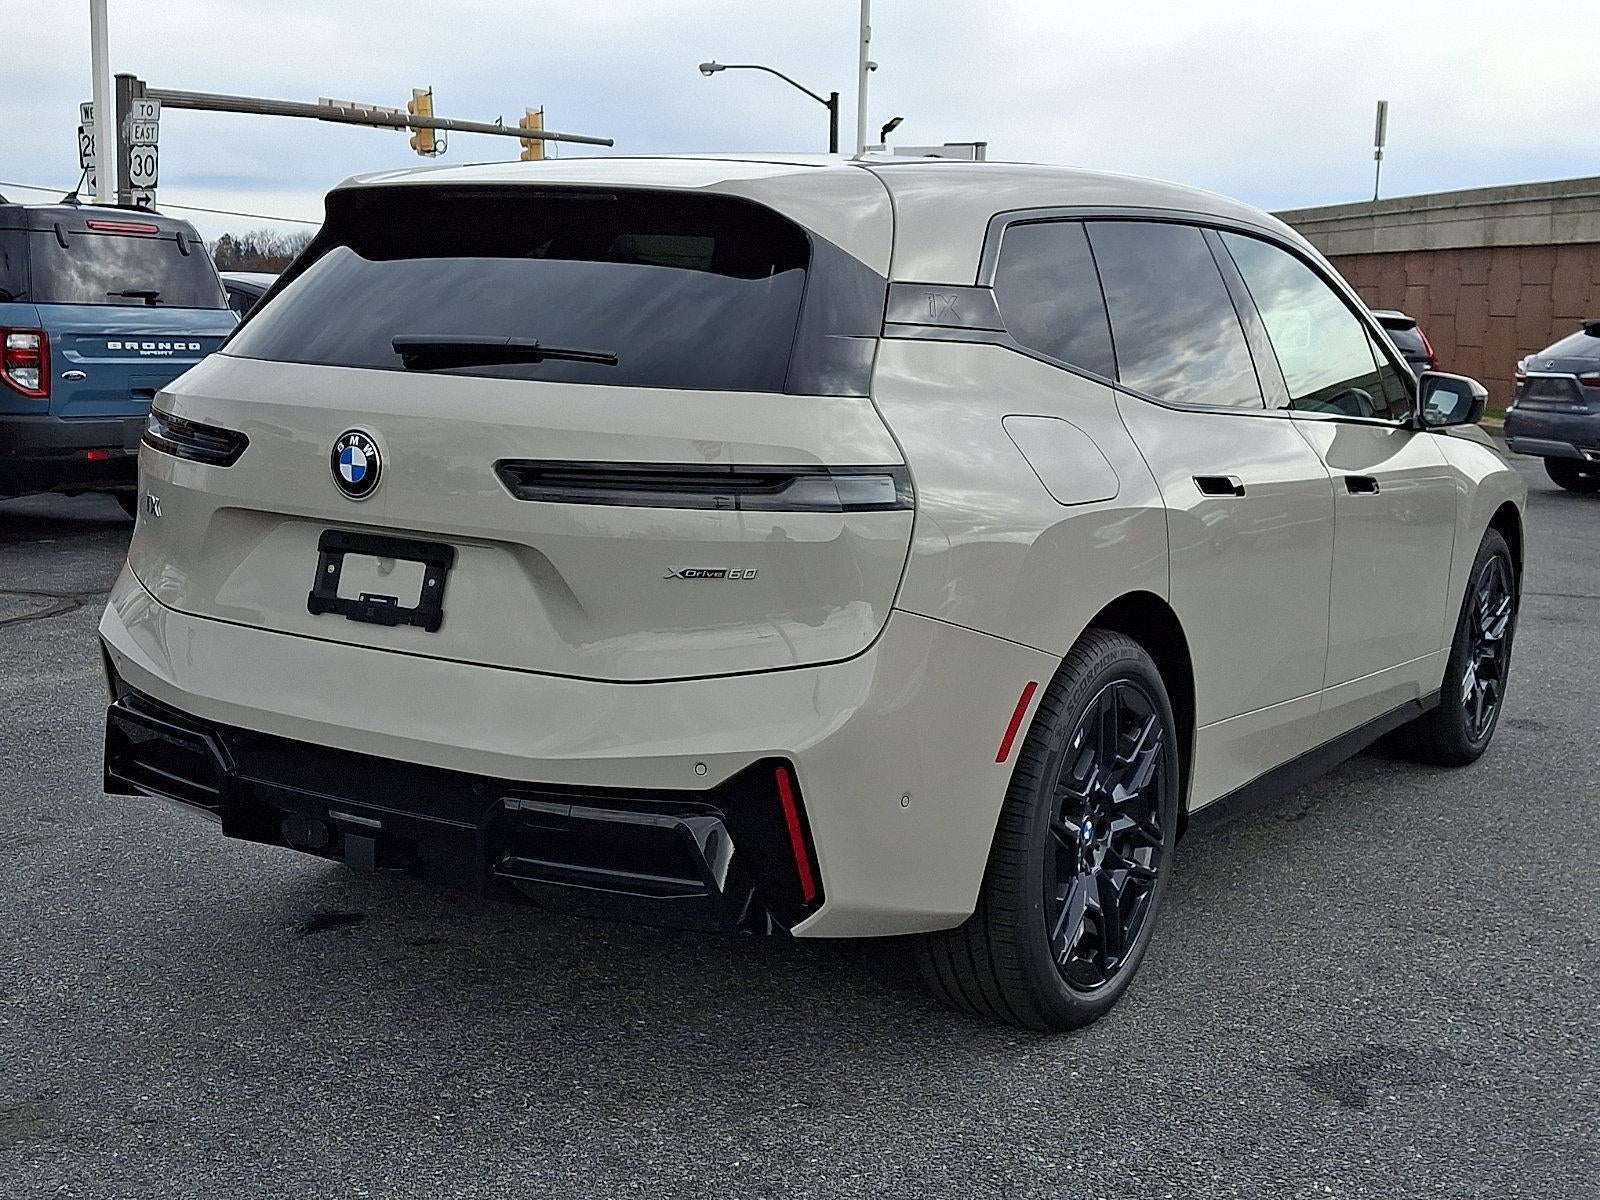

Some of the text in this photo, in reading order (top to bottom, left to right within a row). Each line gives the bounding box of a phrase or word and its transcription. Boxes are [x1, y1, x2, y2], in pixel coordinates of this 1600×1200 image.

[83, 107, 93, 119] WE
[140, 104, 154, 116] TO
[135, 126, 155, 139] EAST
[133, 154, 155, 177] 30
[107, 341, 201, 350] BRONCO
[337, 435, 374, 457] BMW
[728, 568, 758, 579] 60
[1066, 651, 1118, 716] SCORPION
